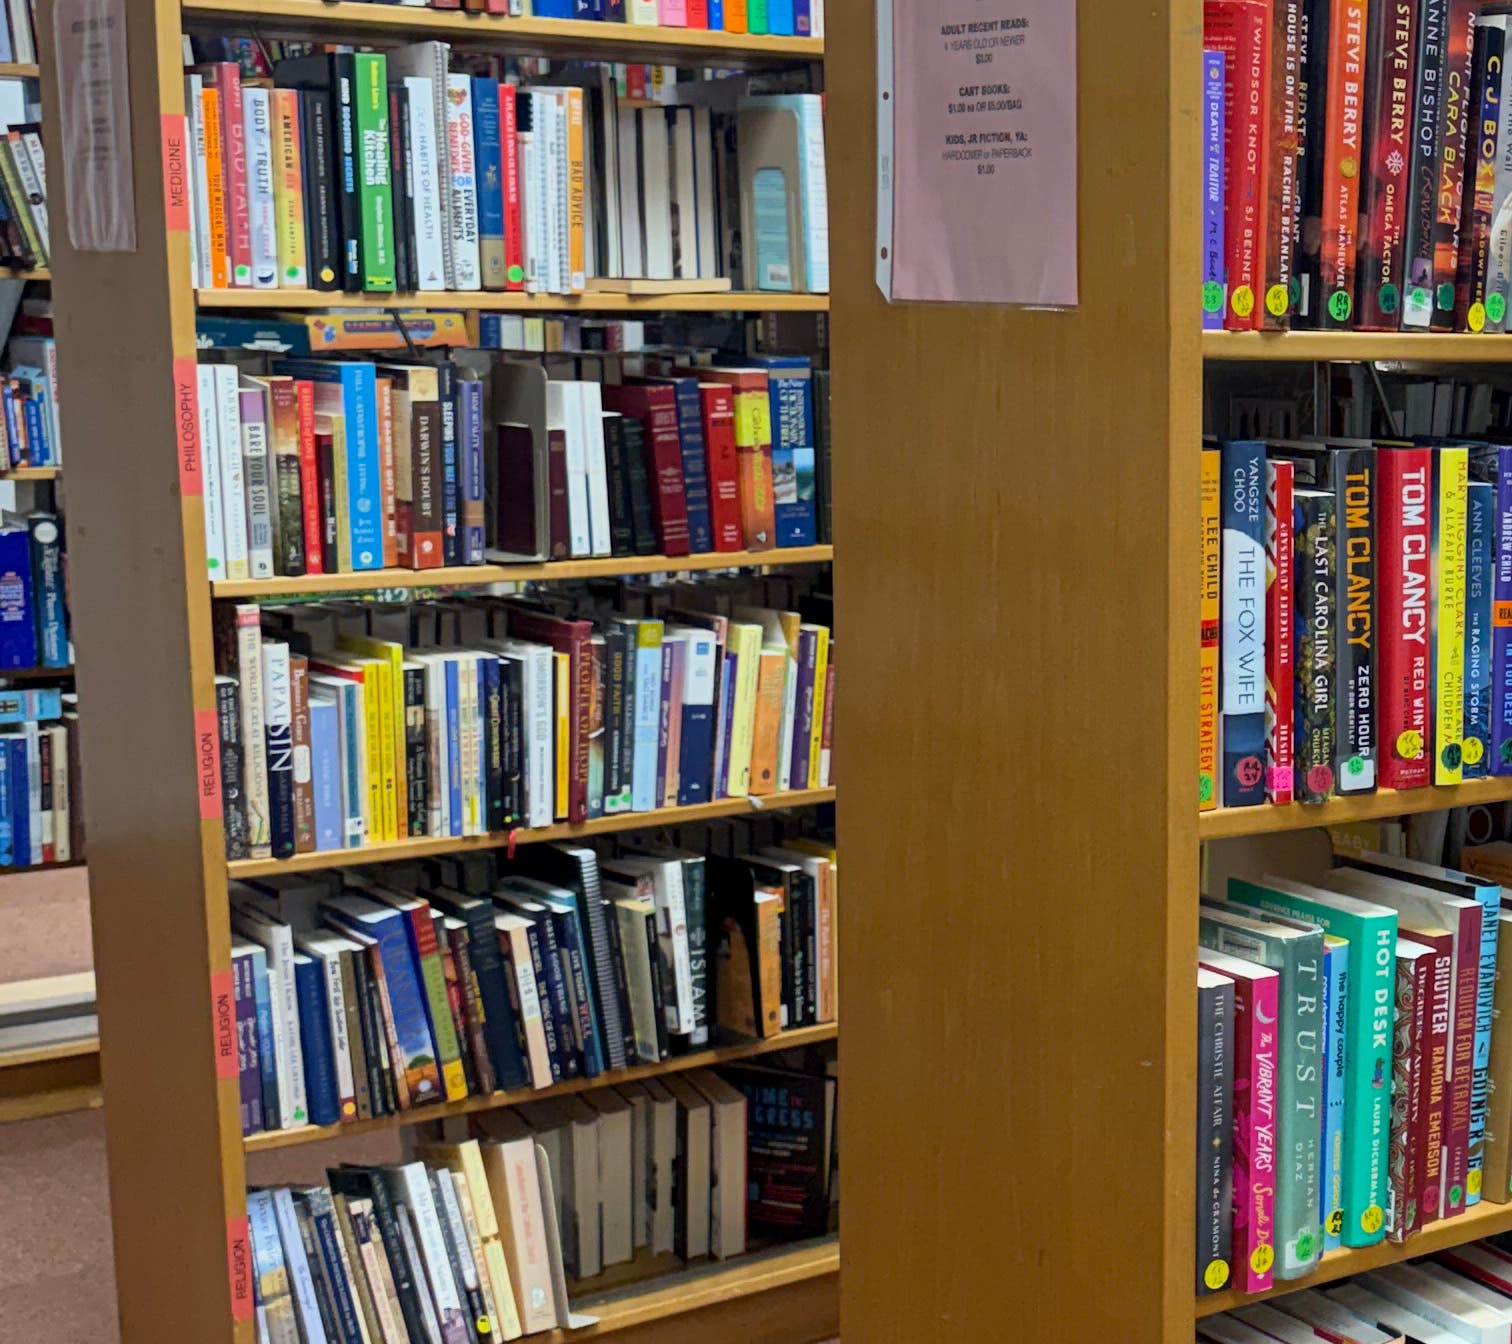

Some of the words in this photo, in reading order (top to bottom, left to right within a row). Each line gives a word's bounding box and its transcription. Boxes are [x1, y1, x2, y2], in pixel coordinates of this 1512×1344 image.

[1346, 7, 1361, 74] STEVE
[1394, 5, 1410, 70] STEVE
[1250, 27, 1262, 116] WINDSOR
[1486, 55, 1501, 113] C.J.
[1343, 82, 1358, 149] BERRY
[1391, 77, 1407, 144] BERRY
[1420, 69, 1435, 157] BISHOP
[167, 138, 183, 207] MEDICINE
[363, 130, 375, 185] Kitchen
[375, 130, 388, 185] Healing
[571, 161, 583, 182] BAD
[1247, 126, 1258, 174] KNOT
[1482, 120, 1497, 186] BOX
[464, 190, 476, 243] EVERYDAY
[572, 187, 583, 227] ADVICE
[178, 383, 196, 472] PHILOSOPHY
[1346, 469, 1369, 529] TOM
[1402, 468, 1425, 526] TOM
[1238, 548, 1256, 588] THE
[1346, 535, 1370, 649] CLANCY
[1402, 532, 1425, 644] CLANCY
[1238, 599, 1255, 643] FOX
[271, 658, 285, 722] PAPAL
[1238, 650, 1254, 705] WIFE
[200, 733, 214, 796] RELIGION
[270, 725, 293, 771] SIN
[1376, 929, 1390, 978] HOT
[690, 948, 707, 1024] ISLAM
[1433, 956, 1450, 1035] SHUTTER
[217, 994, 232, 1057] RELIGION
[1297, 960, 1317, 1118] TRUST
[1374, 990, 1388, 1048] DESK
[1256, 1052, 1274, 1120] VIBRANT
[1255, 1129, 1273, 1171] YEARS
[232, 1239, 245, 1300] RELIGION
